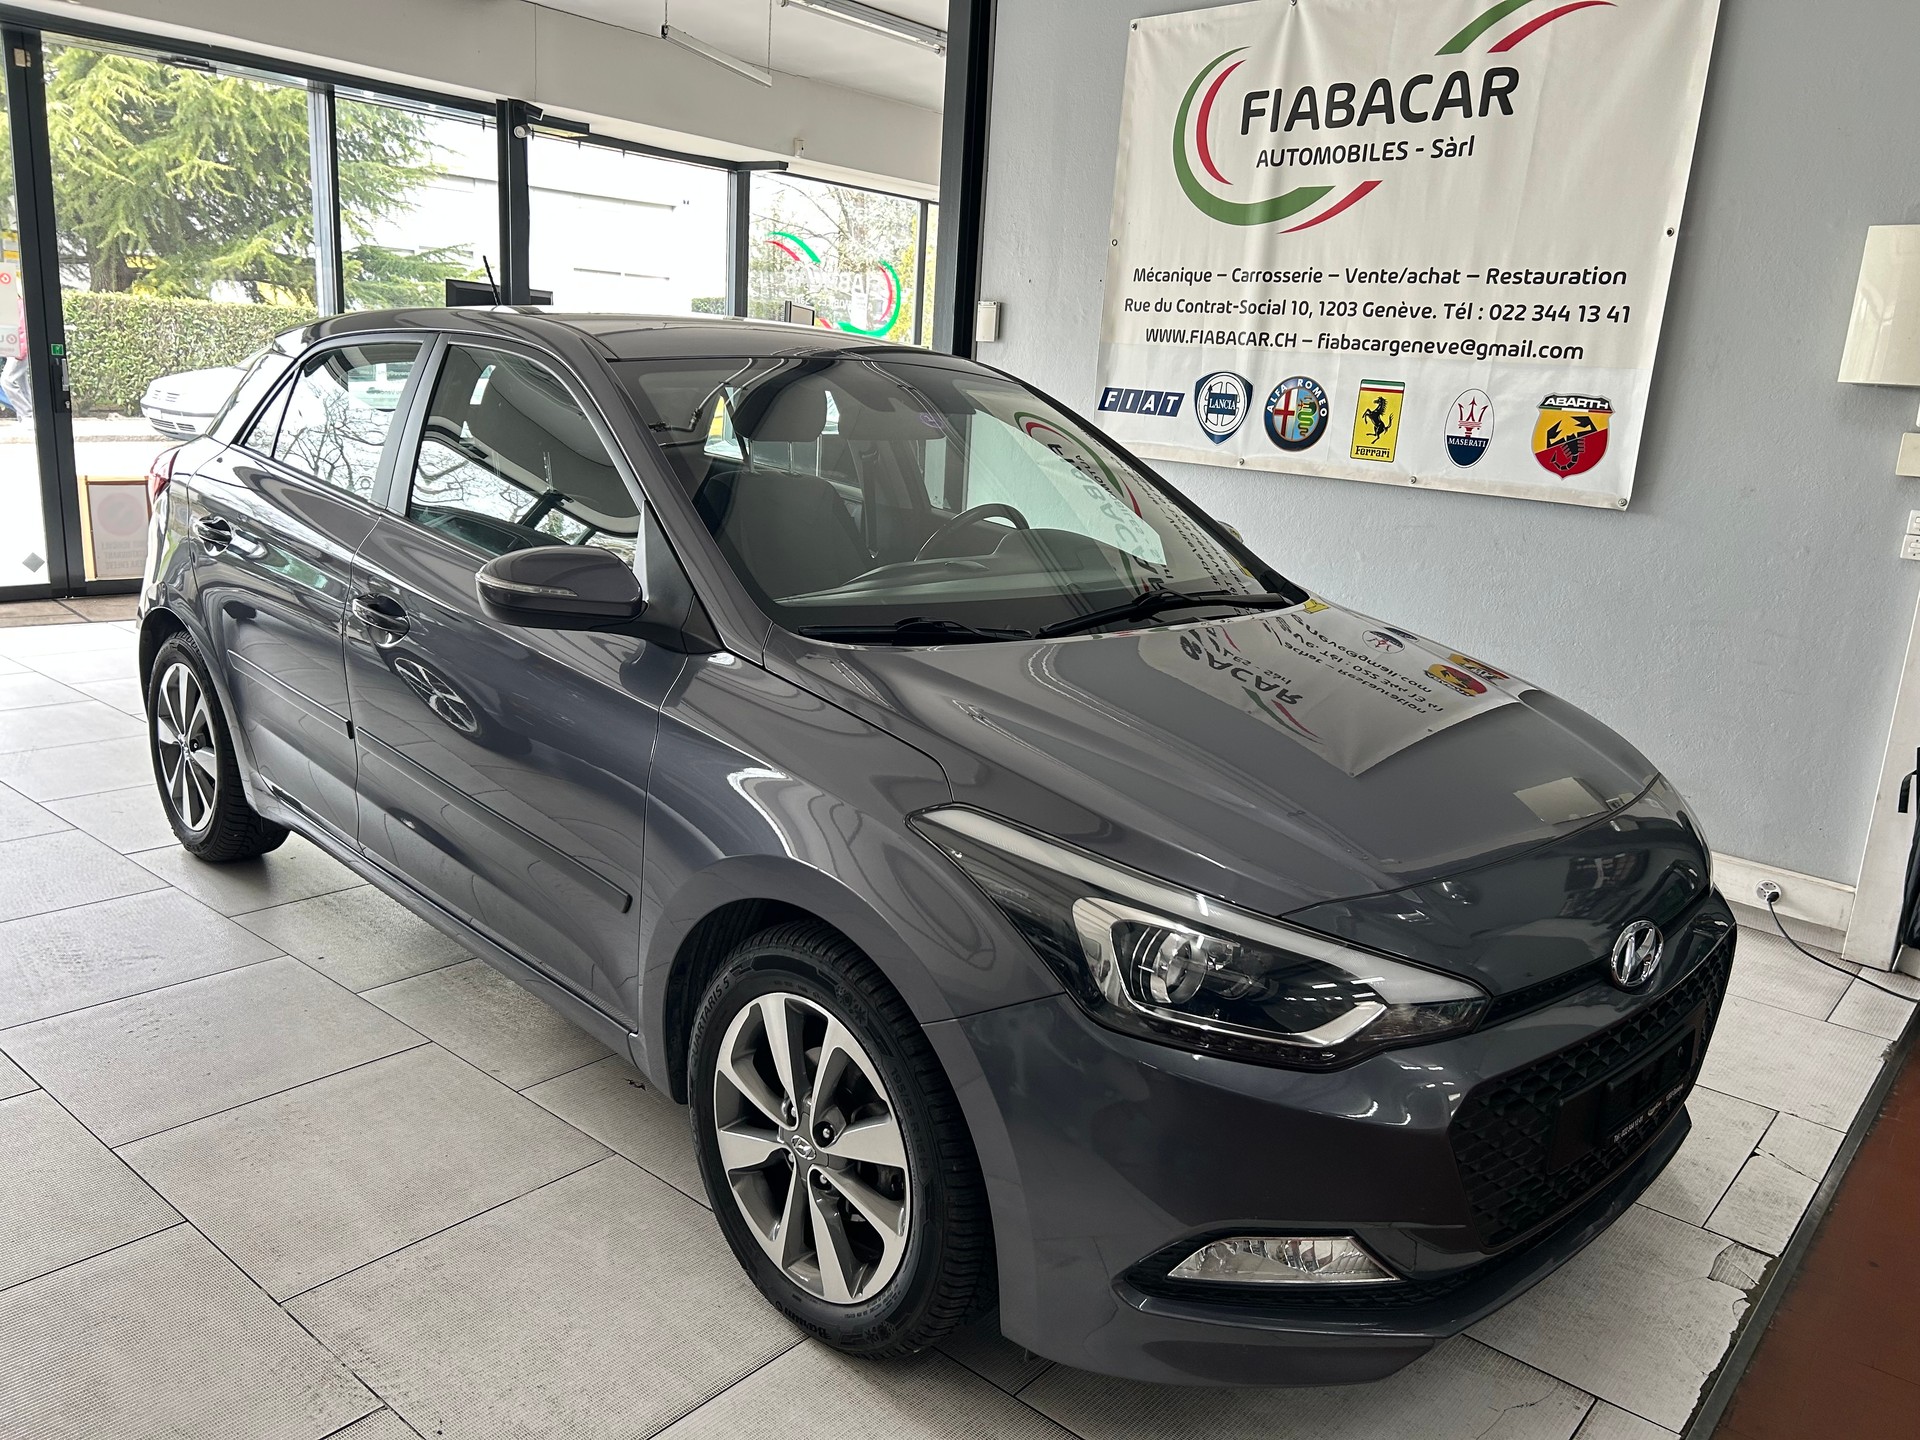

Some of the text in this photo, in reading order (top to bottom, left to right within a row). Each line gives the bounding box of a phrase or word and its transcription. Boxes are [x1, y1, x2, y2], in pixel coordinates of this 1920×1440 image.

[1240, 66, 1520, 136] FIABACAR
[1255, 140, 1409, 169] AUTOMOBILES
[1430, 135, 1475, 159] Sàrl
[1132, 266, 1212, 287] Mécanique
[1231, 266, 1323, 284] Carrosserie
[1345, 266, 1461, 285] Vente/achat
[1485, 265, 1627, 286] Restauration
[1124, 297, 1151, 313] Rue
[1154, 298, 1172, 313] du
[1176, 298, 1286, 316] Contrat-Social
[1291, 300, 1313, 319] 10,
[1318, 300, 1358, 317] 1203
[1362, 301, 1437, 320] Genève.
[1443, 301, 1473, 320] Tél
[1488, 303, 1527, 321] 022
[1531, 304, 1571, 323] 344
[1577, 304, 1601, 323] 13
[1606, 304, 1631, 324] 41
[1145, 327, 1297, 348] WWW.FIABACAR.CH
[1316, 332, 1584, 361] fiabacargeneve@gmail.com
[1103, 390, 1180, 414] FIAT
[1208, 397, 1237, 411] LANCIA
[1266, 377, 1328, 418] ALFA ROMEO
[1544, 396, 1609, 410] ABARTH
[1354, 445, 1391, 460] Ferrari
[1448, 436, 1487, 449] MASERATI
